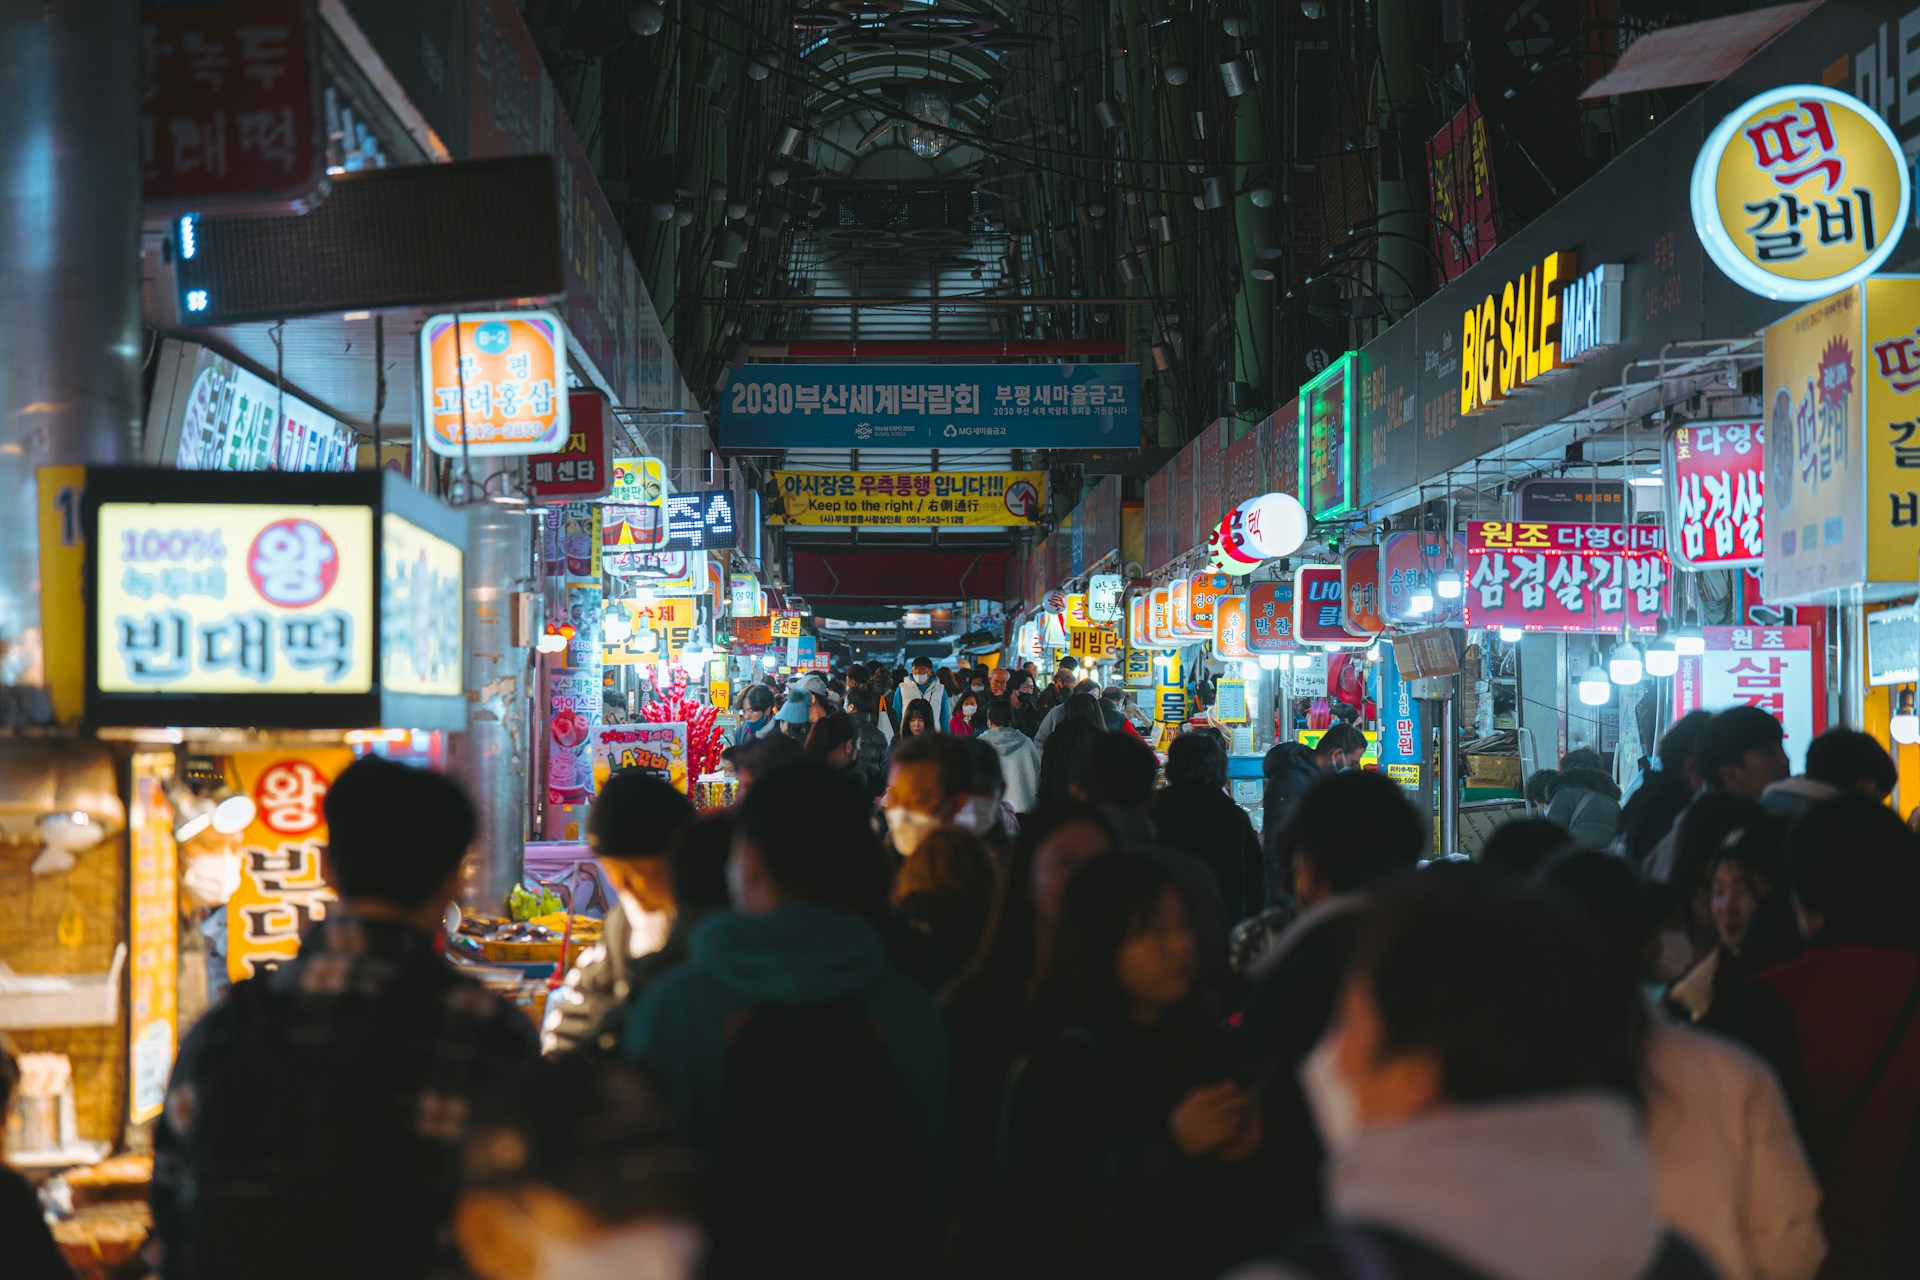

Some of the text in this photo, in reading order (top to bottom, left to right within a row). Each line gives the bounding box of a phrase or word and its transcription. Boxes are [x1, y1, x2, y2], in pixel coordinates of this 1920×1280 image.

[1747, 101, 1843, 190] 떡
[1744, 188, 1874, 261] 갈비
[1461, 251, 1604, 416] BIG SALE MART
[434, 381, 556, 419] 고려홍삼
[732, 382, 981, 416] 2030부산세계박람회
[994, 407, 1014, 416] 2030
[1016, 407, 1029, 416] 부산
[1032, 407, 1046, 416] 세계
[995, 385, 1125, 406] 부평새마을금고
[1677, 428, 1691, 459] 원조
[784, 474, 1004, 497] 야시장은 우측통행 입니다!!!
[809, 500, 841, 512] Keep
[844, 501, 858, 511] to
[861, 500, 880, 511] the
[884, 499, 914, 513] right
[928, 499, 980, 512] 右側通行
[906, 515, 964, 524] 051-243-1128
[1679, 469, 1765, 560] 삼겹살
[1480, 521, 1665, 549] 원조 다영이네
[121, 522, 335, 605] 100% 왕
[1350, 583, 1378, 616] 영대
[1469, 552, 1668, 616] 삼겹살김밥
[1256, 617, 1291, 636] 반찬
[1732, 629, 1785, 649] 원조
[119, 610, 352, 683] 빈대떡
[1397, 720, 1414, 755] 만원
[607, 747, 669, 772] LA갈비
[1389, 766, 1419, 774] 위치추적기
[260, 763, 328, 832] 왕
